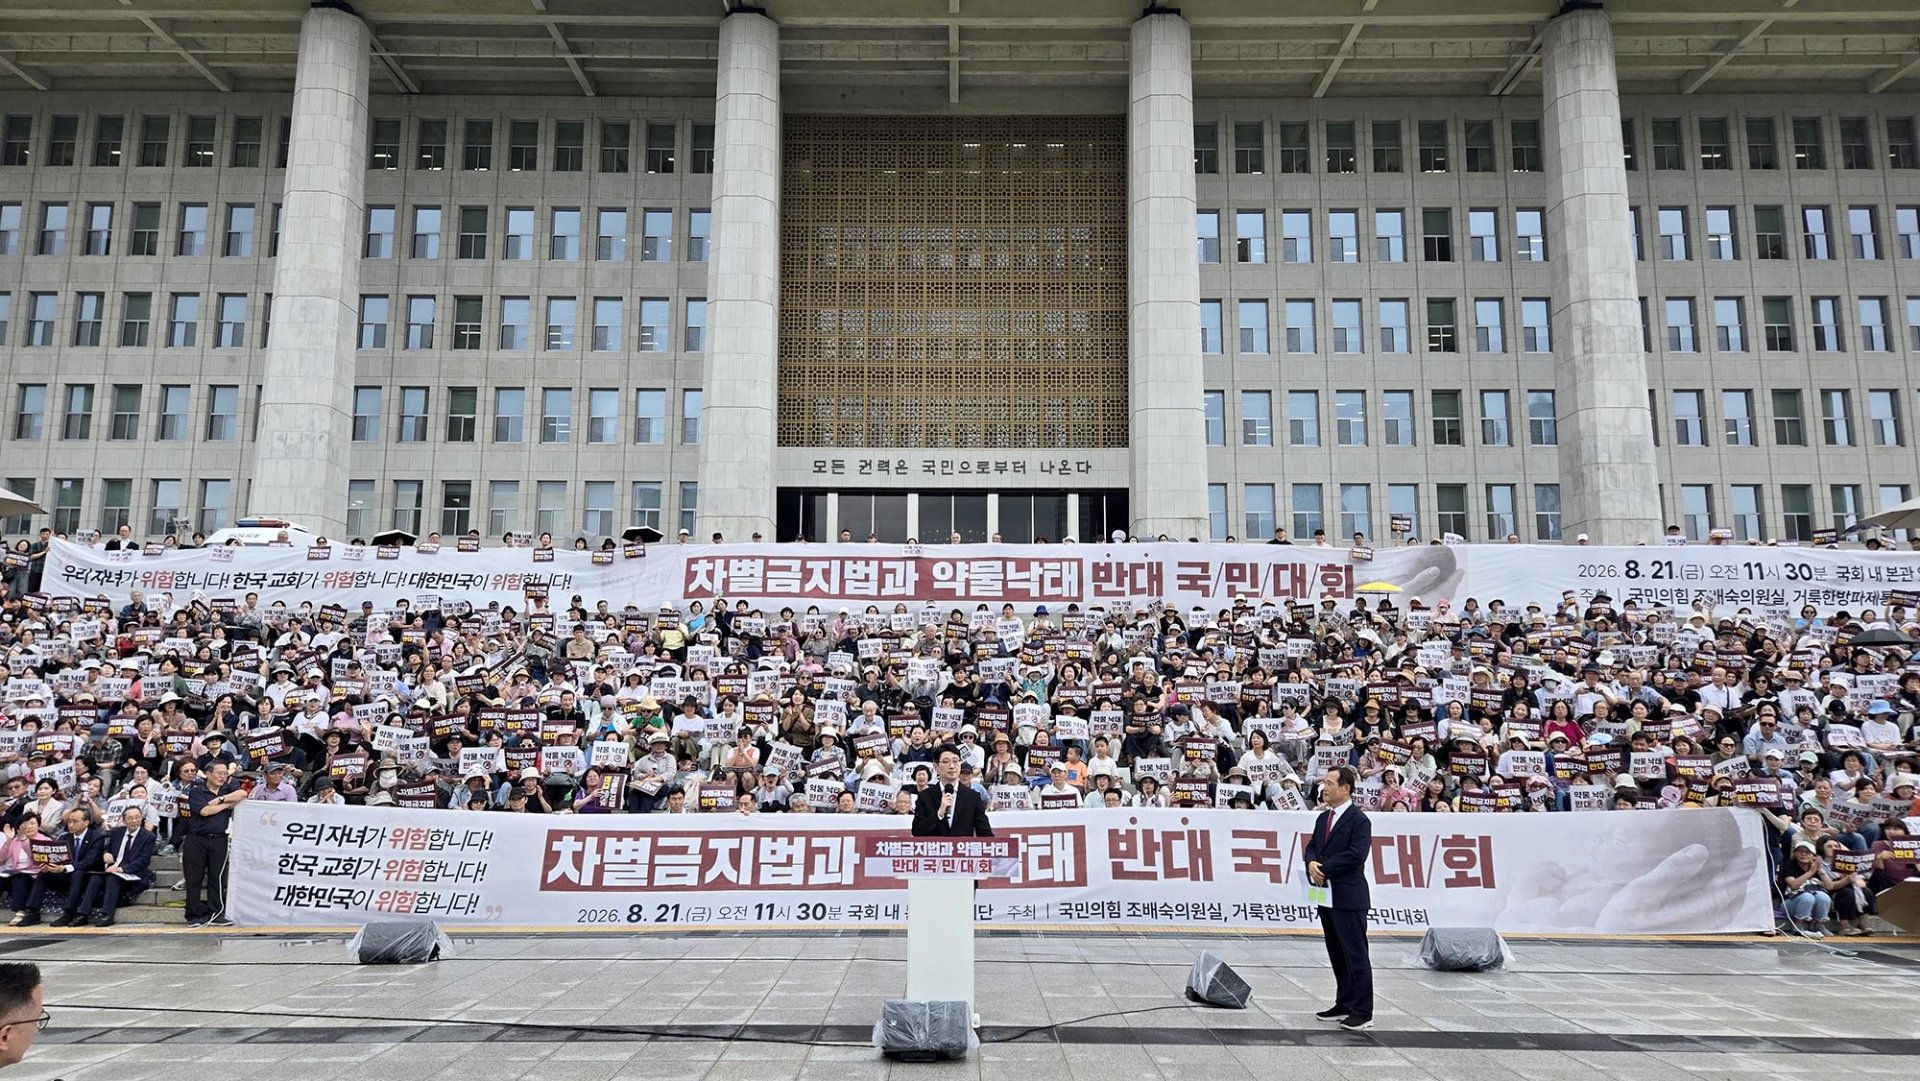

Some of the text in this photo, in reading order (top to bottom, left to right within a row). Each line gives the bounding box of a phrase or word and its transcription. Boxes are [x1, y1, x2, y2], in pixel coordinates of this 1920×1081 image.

[812, 459, 1092, 475] 모든 권력은 국민으로부터 나온다
[62, 565, 93, 585] 우리
[91, 569, 138, 588] 자녀가
[140, 570, 229, 590] 위험합니다!
[233, 572, 267, 590] 한국
[268, 572, 319, 590] 교회가
[321, 570, 407, 590] 위험합니다!
[409, 572, 488, 591] 대한민국이
[687, 558, 1354, 600] 차별금지법과 약물낙태 반대 국/민/대/회
[1578, 564, 1620, 578] 2026.
[1625, 560, 1645, 579] 8.
[1709, 564, 1739, 580] 오전
[1744, 562, 1780, 580] 11시
[1784, 563, 1828, 582] 30분
[1836, 566, 1864, 582] 국회
[1867, 566, 1882, 582] 내
[1886, 566, 1914, 582] 본관
[1628, 588, 1689, 605] 국민의힘
[282, 822, 494, 852] 우리 자녀가 위험합니다!
[546, 835, 860, 887] 차별금지법과
[1108, 827, 1214, 883] 반대
[875, 841, 1008, 857] 차별금지법과 약물낙태
[277, 853, 488, 884] 한국 교회가 위험합니다!
[892, 858, 993, 874] 반대 국/민/대/회
[273, 885, 480, 916] 대한민국이 위험합니다!
[1007, 904, 1036, 920] 주최
[1058, 901, 1120, 920] 국민의힘
[1126, 902, 1228, 922] 조배숙의원실,
[577, 908, 621, 923] 2026.
[626, 903, 648, 923] 8.
[716, 905, 747, 922] 오전
[754, 903, 791, 921] 11시
[796, 903, 843, 921] 30분
[847, 903, 879, 922] 국회
[883, 903, 900, 921] 내
